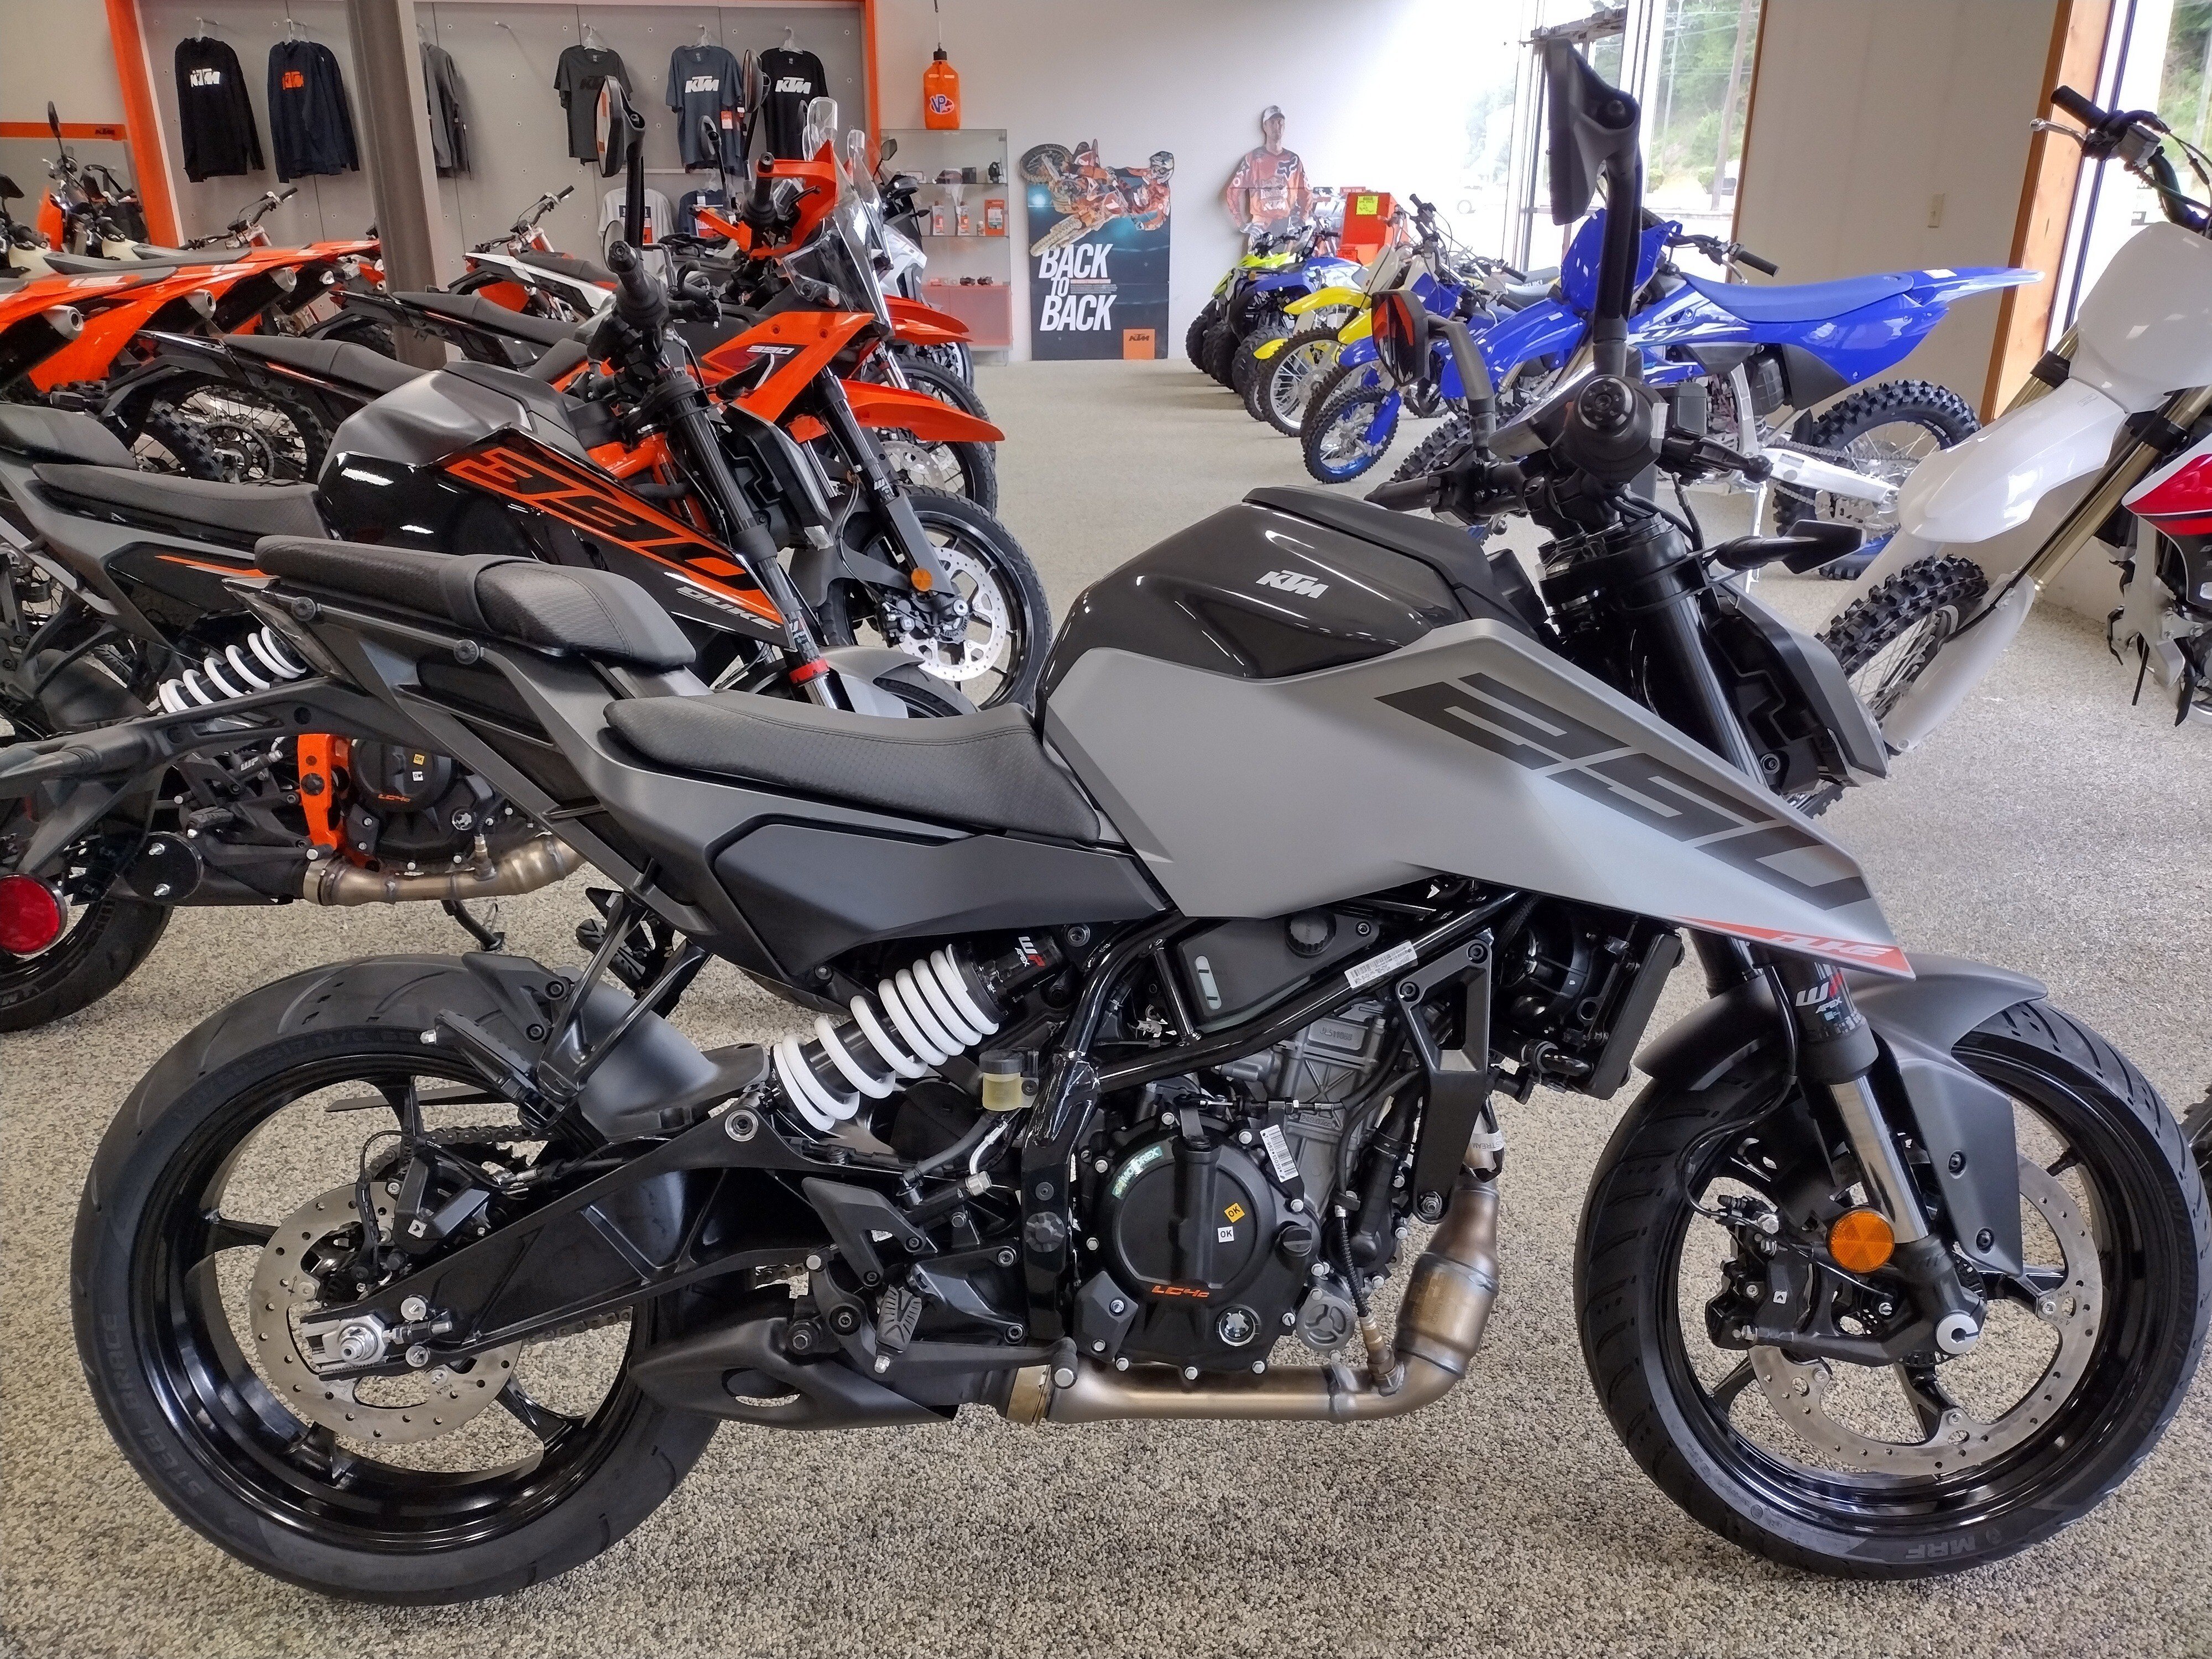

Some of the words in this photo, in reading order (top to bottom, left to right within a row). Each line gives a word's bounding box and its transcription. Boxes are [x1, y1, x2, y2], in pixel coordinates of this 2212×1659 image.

[685, 75, 719, 93] KTM
[775, 76, 812, 94] KTM
[1039, 243, 1113, 279] BACK
[1051, 276, 1070, 297] TO
[1040, 294, 1117, 331] BACK
[1129, 333, 1150, 342] KTM
[747, 345, 795, 355] 390
[1256, 570, 1329, 599] KTM
[675, 585, 782, 630] DUKE
[241, 756, 259, 771] WP
[1374, 672, 1871, 911] 250
[1771, 934, 1895, 957] DUKE
[1014, 947, 1030, 967] APEX
[1815, 996, 1843, 1014] APEX
[1228, 1206, 1240, 1217] OK
[1220, 1229, 1233, 1238] OK
[1905, 1534, 1976, 1559] MRF
